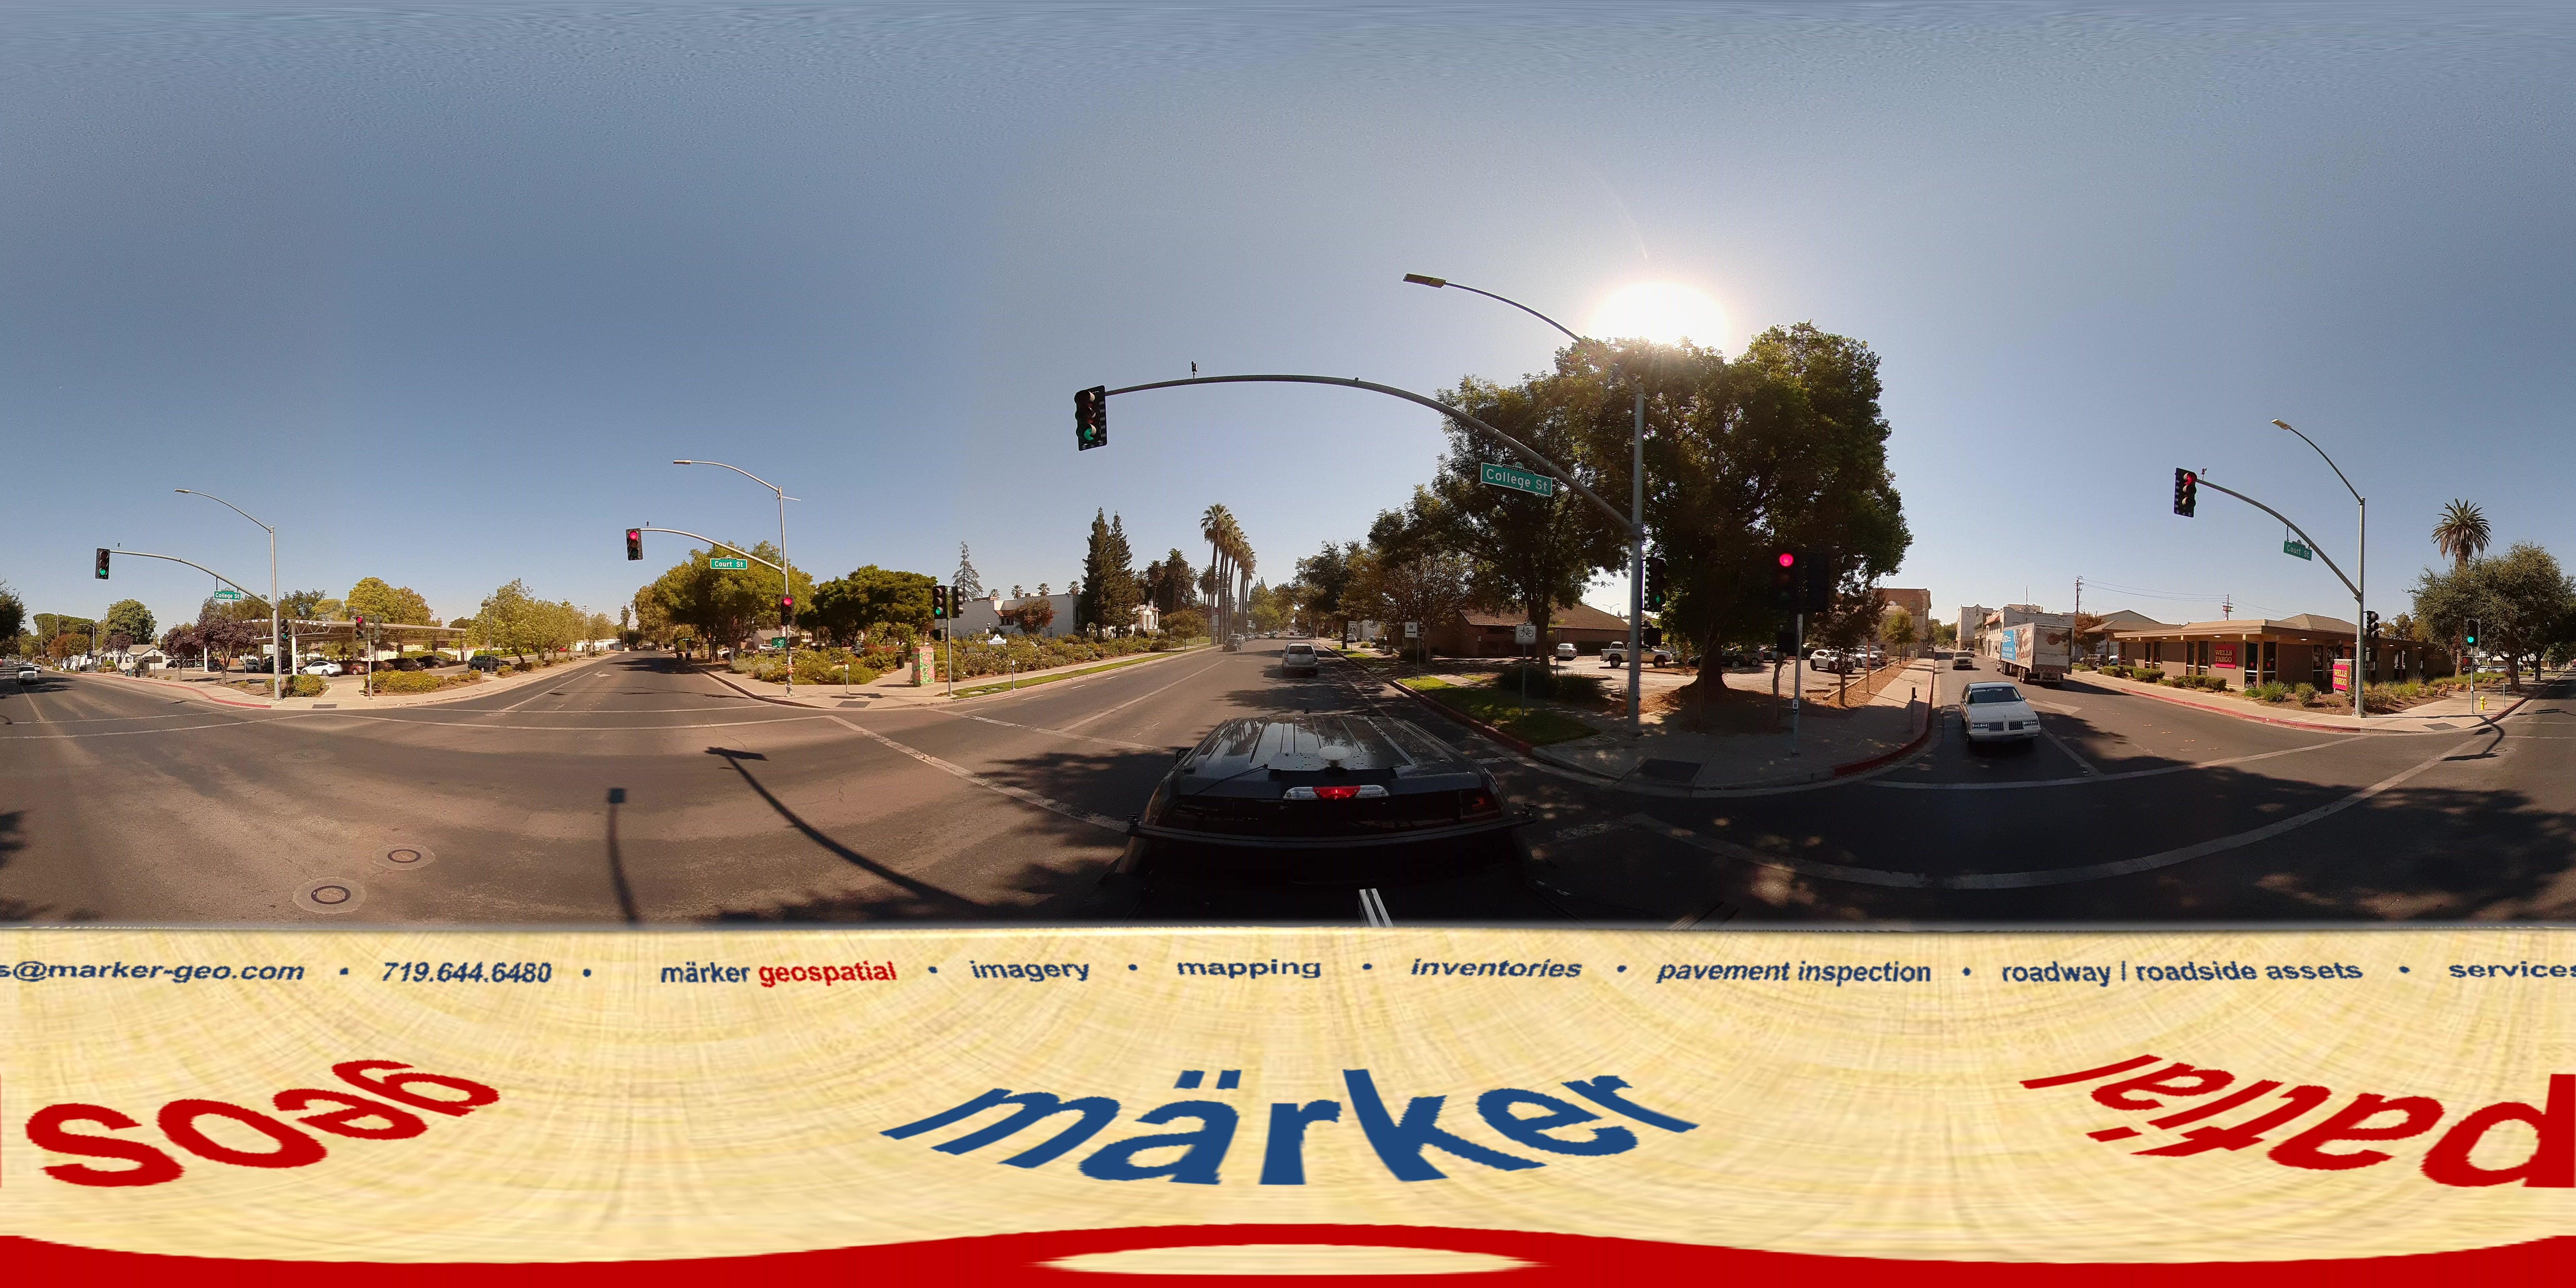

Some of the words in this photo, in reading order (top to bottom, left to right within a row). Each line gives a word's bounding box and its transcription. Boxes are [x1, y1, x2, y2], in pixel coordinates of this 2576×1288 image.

[1486, 469, 1530, 489] College
[1536, 479, 1547, 491] St
[2287, 545, 2301, 555] Court
[2334, 669, 2347, 677] WELLS
[2334, 677, 2347, 686] FARGO
